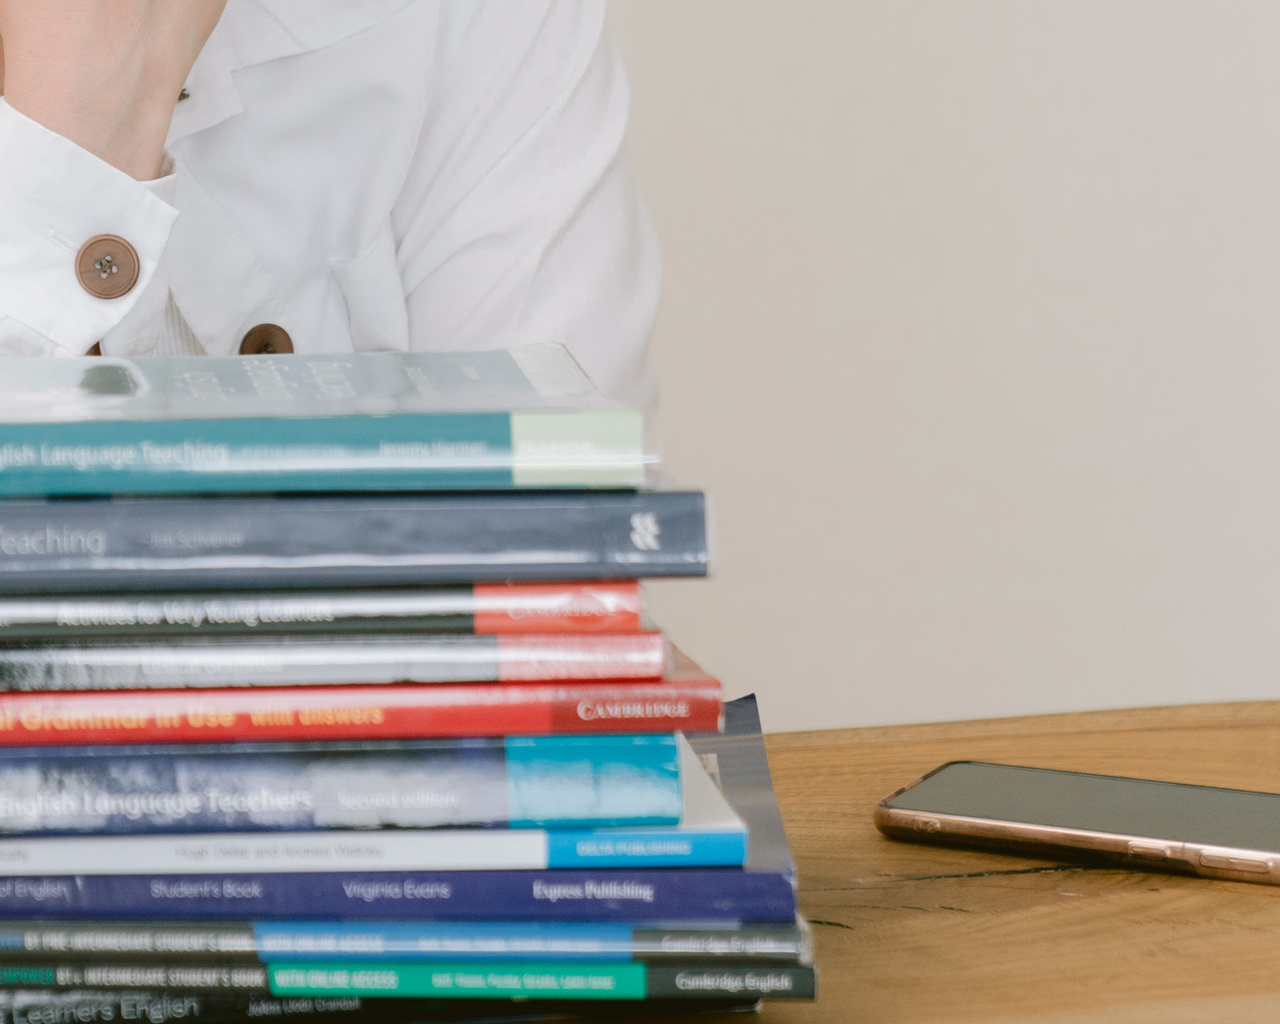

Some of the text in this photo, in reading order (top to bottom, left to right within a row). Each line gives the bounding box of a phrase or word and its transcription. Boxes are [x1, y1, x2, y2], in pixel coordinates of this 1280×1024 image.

[41, 442, 135, 471] Language
[140, 439, 227, 468] Teaching
[57, 598, 335, 627] Activities for Very Young Learners
[20, 707, 147, 732] Grammar
[155, 704, 179, 727] in
[188, 704, 236, 727] Use
[250, 707, 295, 727] with
[299, 707, 384, 725] answers
[577, 700, 690, 721] CAMBRIDGE
[84, 791, 201, 820] Language
[208, 788, 313, 814] Teachers
[338, 790, 458, 811] Second edition
[616, 840, 692, 856] PUBLISHING
[15, 878, 70, 901] English
[150, 879, 262, 899] Student's Book
[342, 879, 452, 902] Virginia Evans
[533, 880, 654, 903] Express Publishing
[219, 931, 256, 952] BOOK
[84, 966, 167, 987] INTERMEDIATE
[169, 967, 229, 988] STUDENT'S
[231, 967, 266, 988] BOOK
[274, 969, 399, 989] WITH ONLINE ACCESS
[676, 972, 793, 993] Cambridge English
[11, 999, 114, 1024] Learners
[119, 996, 199, 1024] English
